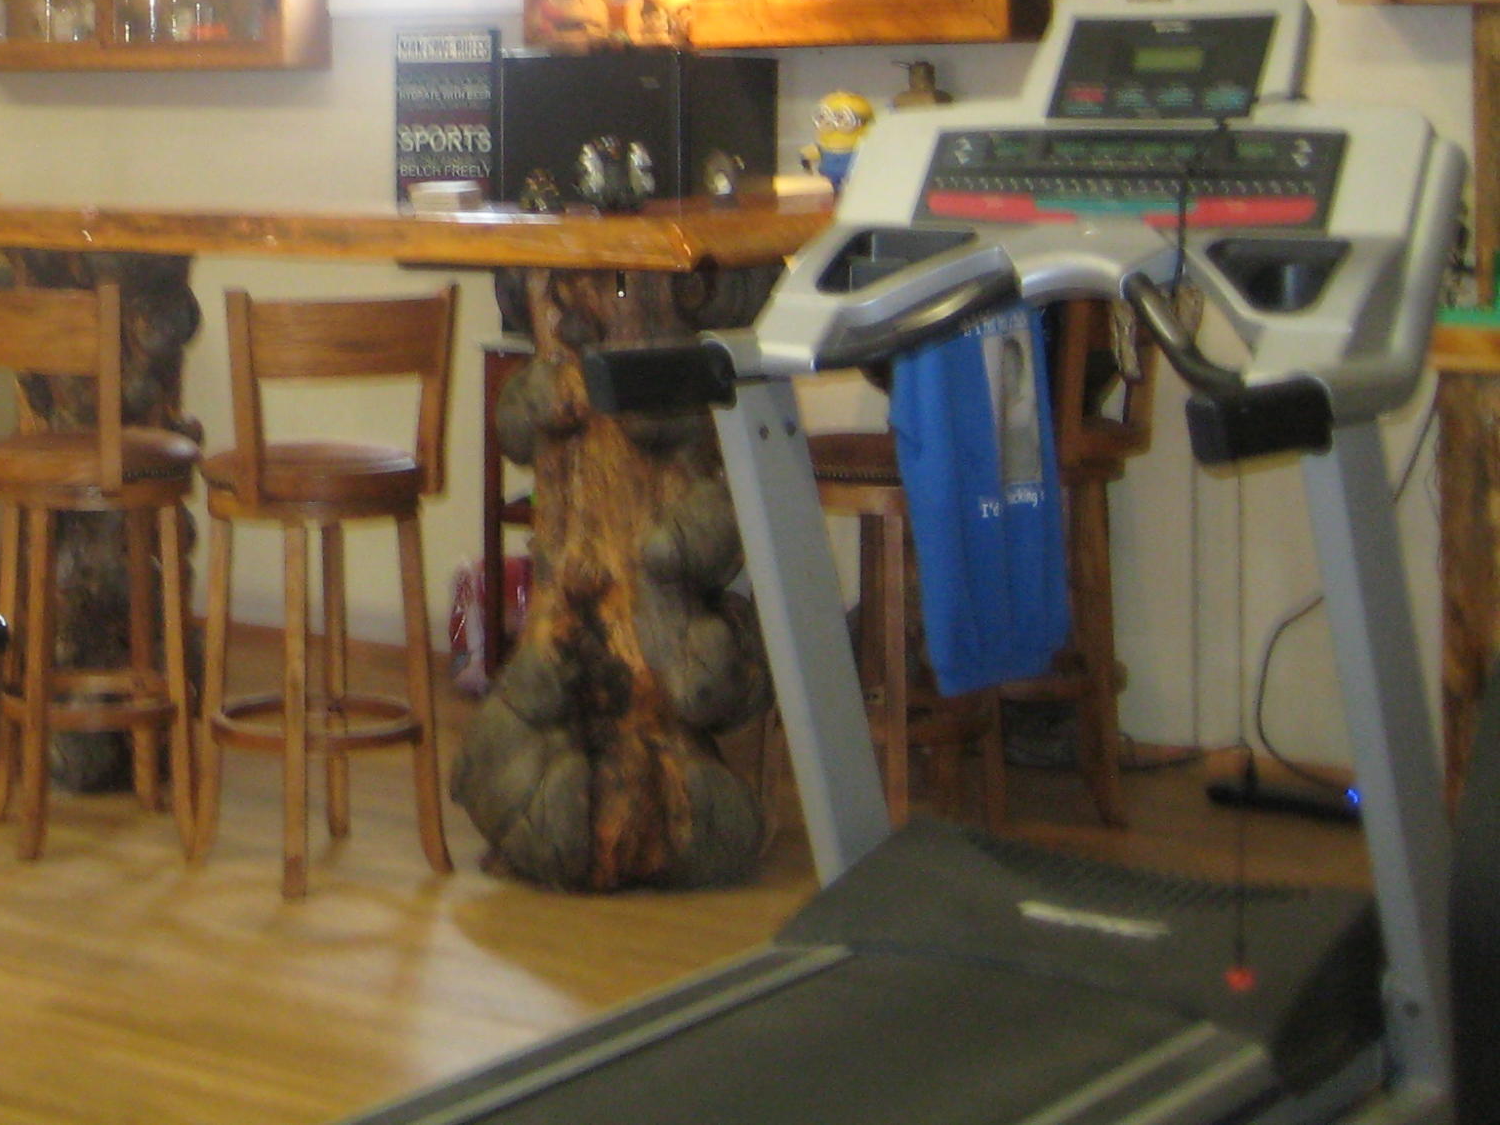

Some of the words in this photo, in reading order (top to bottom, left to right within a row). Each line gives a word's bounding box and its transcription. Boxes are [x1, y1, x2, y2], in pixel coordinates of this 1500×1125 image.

[456, 39, 489, 59] RULES
[399, 129, 492, 153] SPORTS
[399, 164, 441, 177] BELCH
[444, 162, 491, 178] FREELY
